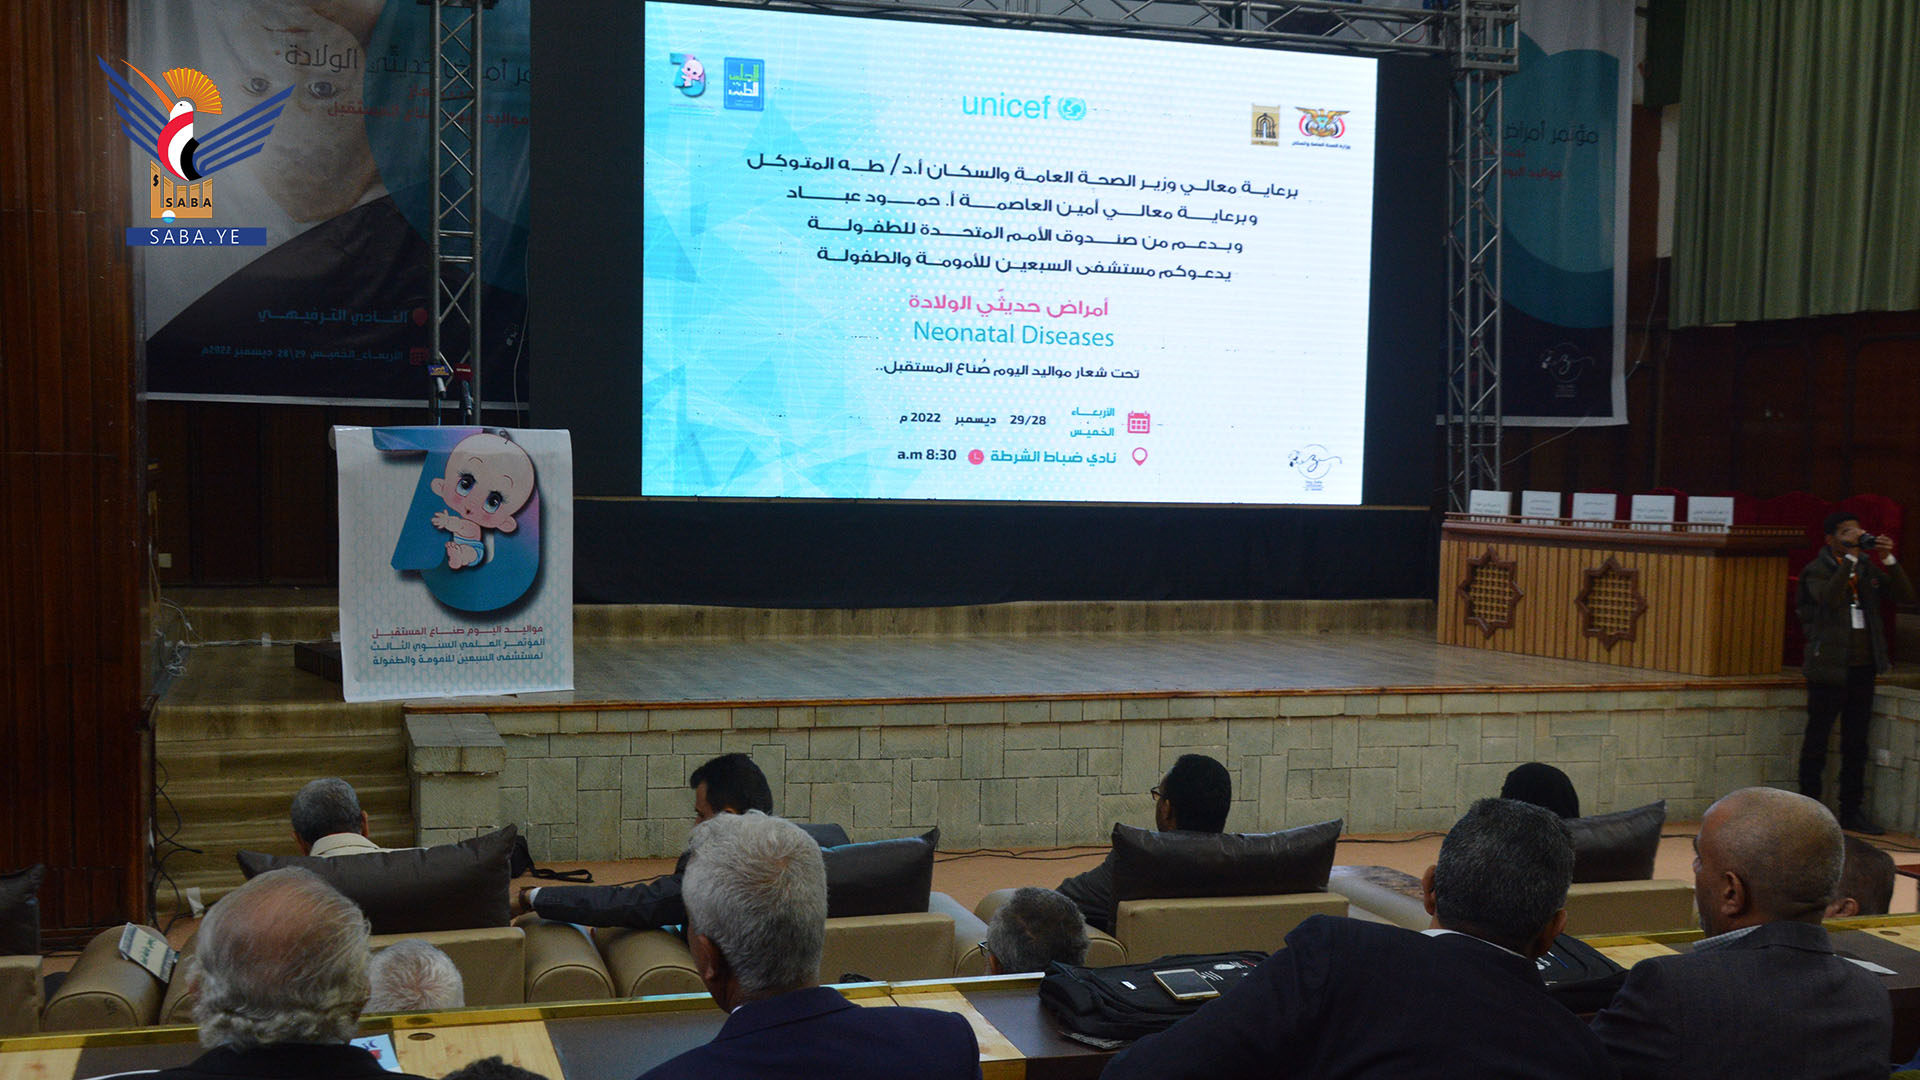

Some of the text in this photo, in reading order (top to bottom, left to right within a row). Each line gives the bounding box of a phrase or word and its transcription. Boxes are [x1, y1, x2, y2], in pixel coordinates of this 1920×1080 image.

[285, 43, 358, 73] الولادة
[962, 92, 1051, 121] unicef
[746, 152, 835, 171] المتوكل
[837, 159, 885, 173] طه
[926, 163, 1010, 183] والسكان
[1013, 166, 1074, 184] العامة
[1077, 169, 1136, 188] الصحة
[1139, 176, 1177, 193] وزير
[1179, 178, 1237, 197] معالي
[1240, 180, 1299, 200] برعاية
[786, 185, 861, 206] عباد
[864, 193, 941, 209] حمود
[958, 193, 1053, 214] العاصمة
[1056, 198, 1099, 217] أمين
[1102, 203, 1174, 221] معالي
[1176, 204, 1258, 226] وبرعاية
[807, 215, 1243, 256] وبدعم من صندوق الأمم المتحدة للطفولة
[816, 246, 1232, 284] يدعوكم مستشفى السبعين للأمومة والطفولة
[908, 294, 972, 313] الولادة
[1046, 297, 1109, 319] أمراض
[257, 307, 408, 326] النادي الترفيهي
[913, 320, 1115, 347] Neonatal Diseases
[993, 364, 1029, 378] اليوم
[1031, 365, 1073, 379] مواليد
[1074, 364, 1108, 380] شعار
[1110, 367, 1141, 379] تحت
[899, 412, 1047, 428] 29/28 ديسمبر 2022 م
[1071, 406, 1116, 418] الأربعاء
[1069, 427, 1116, 438] الخميس
[897, 448, 958, 461] a.m 8:30
[990, 448, 1117, 467] نادي ضباط الشرطة
[371, 623, 544, 639] مواليد اليوم صناع المستقبل
[370, 636, 546, 653] المؤتمر العلمي السنوي الثالث
[372, 650, 544, 668] لمستشفى السبعين للأمومة والطفولة
